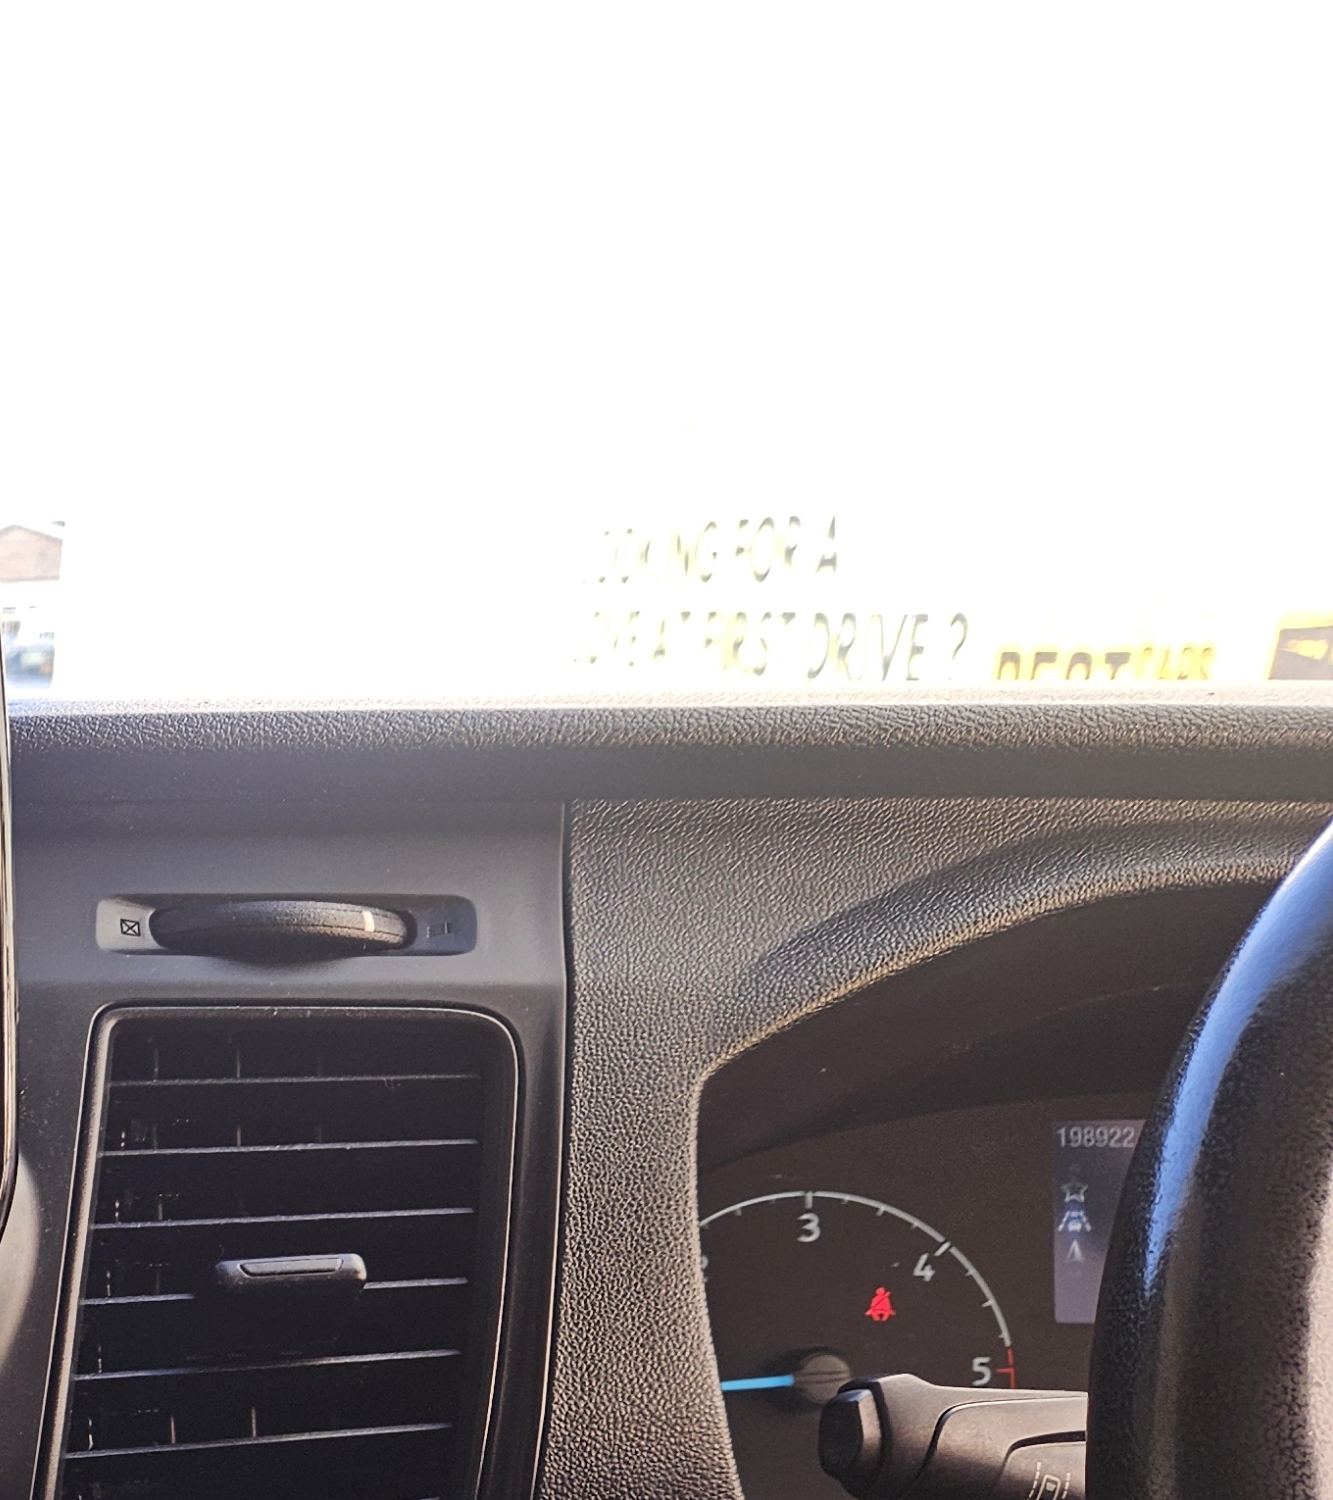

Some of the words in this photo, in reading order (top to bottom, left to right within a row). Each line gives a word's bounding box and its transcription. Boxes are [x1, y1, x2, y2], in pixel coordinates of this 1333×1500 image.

[1056, 1126, 1136, 1148] 198922
[796, 1213, 821, 1243] 3
[912, 1253, 935, 1282] 4
[971, 1356, 992, 1387] 5
